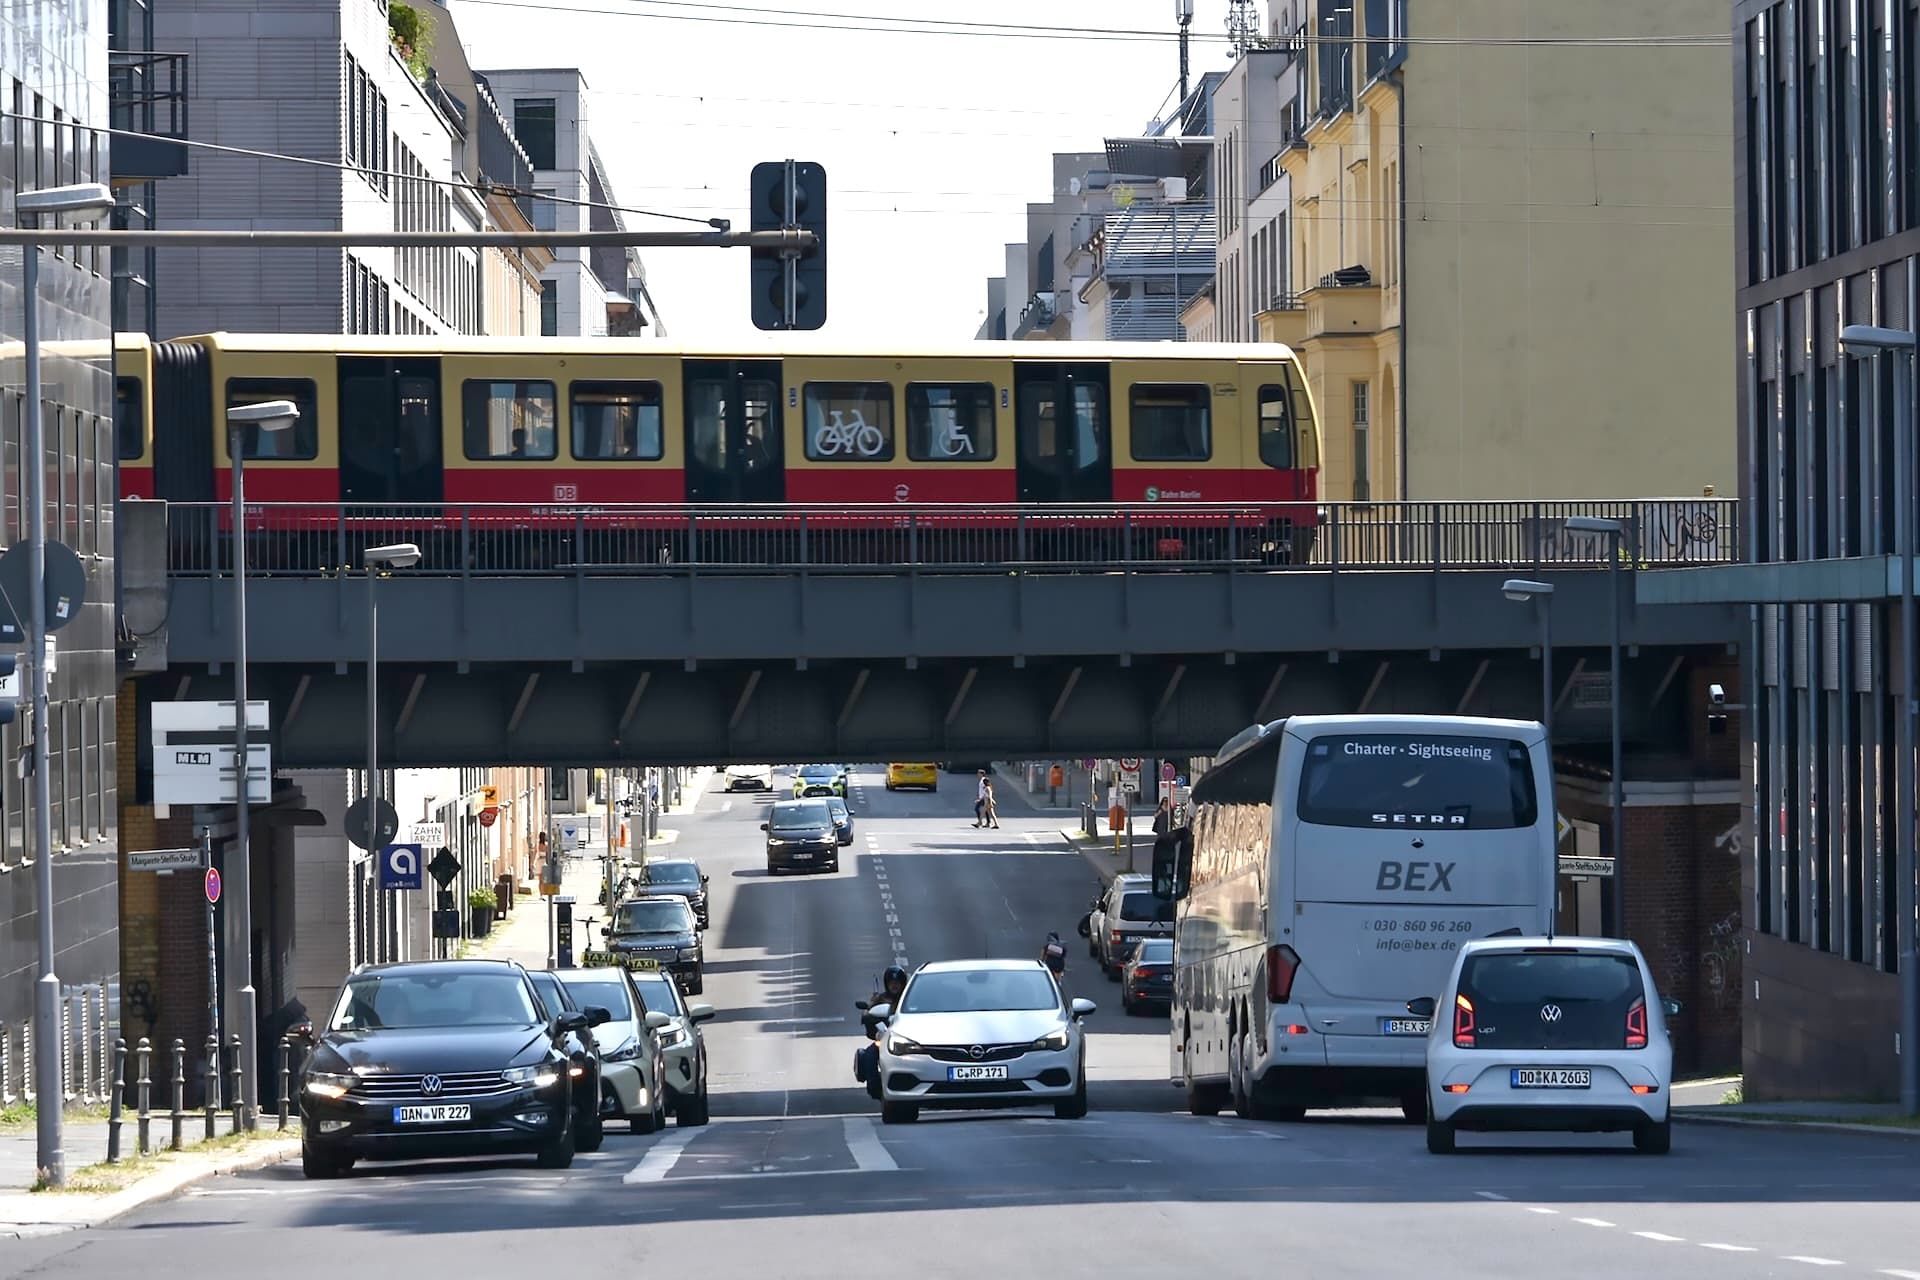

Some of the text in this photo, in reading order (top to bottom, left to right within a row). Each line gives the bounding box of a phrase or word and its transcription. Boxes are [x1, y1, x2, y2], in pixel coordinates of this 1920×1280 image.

[555, 486, 576, 500] DB
[1146, 487, 1158, 501] S
[1344, 742, 1492, 761] Charter Sightseeing
[177, 752, 210, 764] MLM
[1372, 814, 1465, 824] SETRA
[414, 827, 442, 836] ZAHN
[1376, 861, 1456, 892] BEX
[1374, 920, 1472, 932] 030 860 96 260
[587, 953, 611, 962] TAXI
[631, 960, 653, 969] TAXI
[1391, 1021, 1398, 1032] B
[1404, 1022, 1417, 1032] EX
[957, 1067, 1003, 1078] C RP 171
[1520, 1071, 1589, 1084] DO KA 2603
[401, 1106, 469, 1121] DAN VR 227
